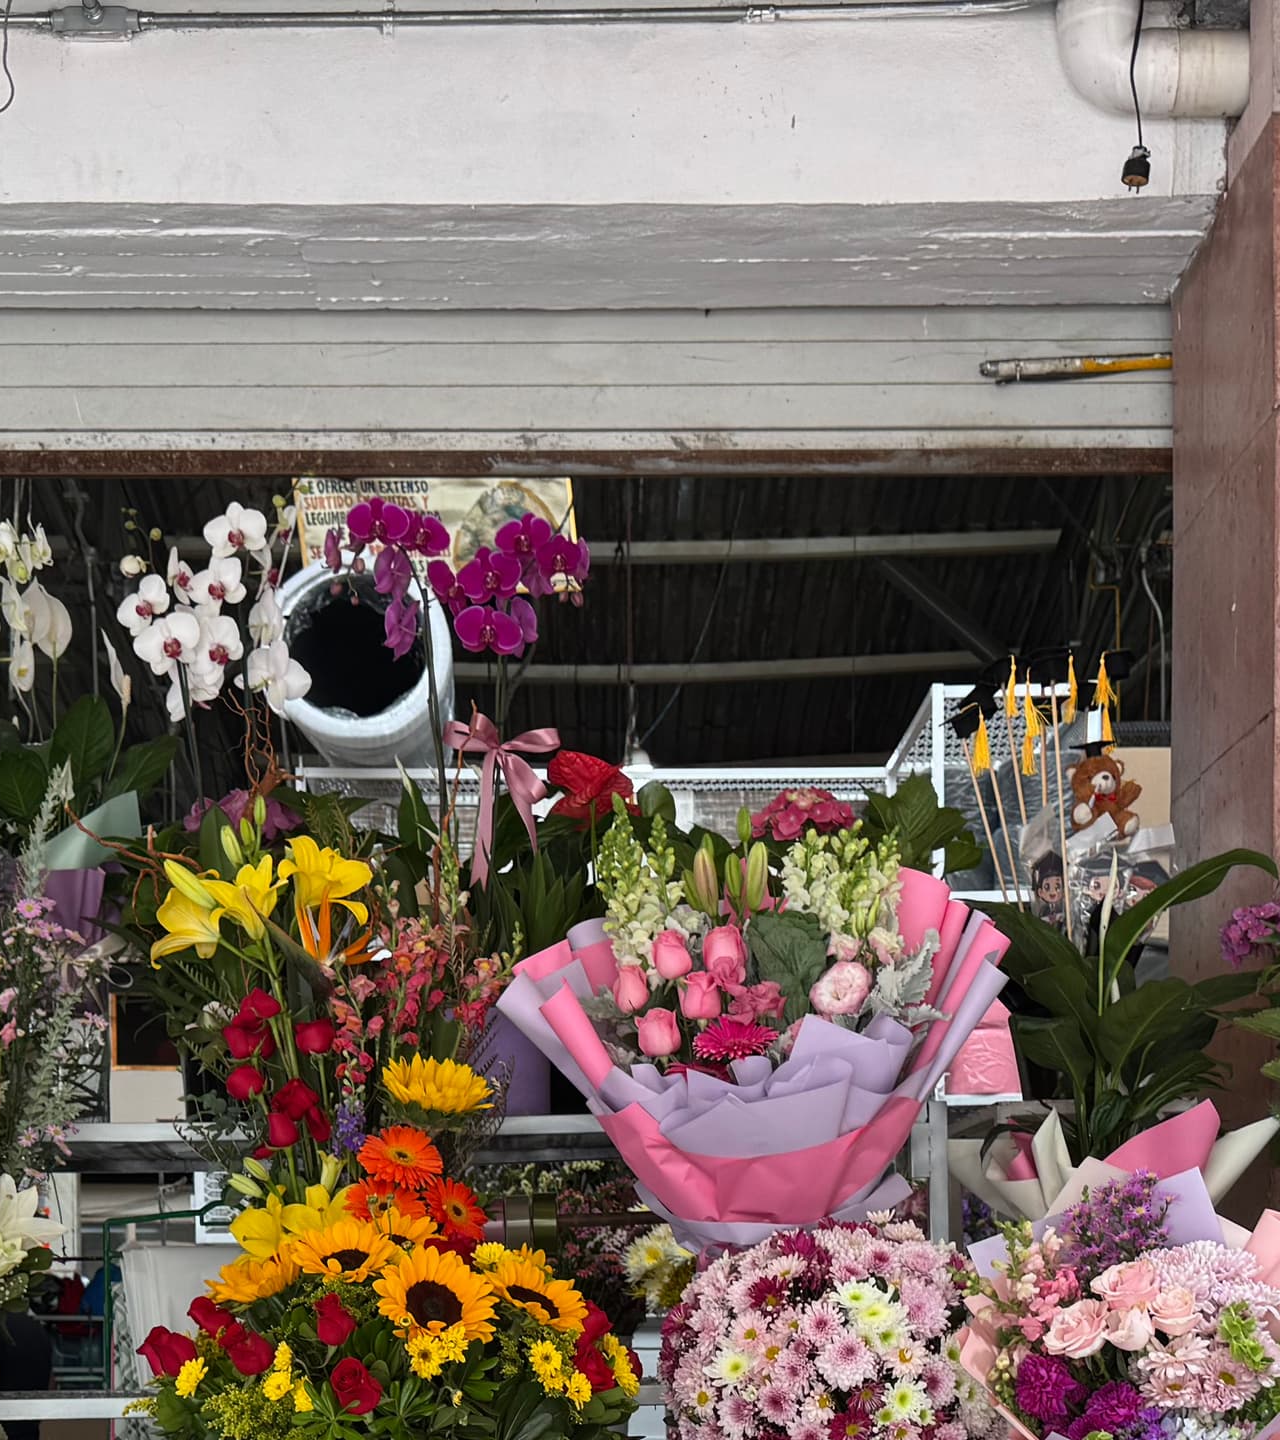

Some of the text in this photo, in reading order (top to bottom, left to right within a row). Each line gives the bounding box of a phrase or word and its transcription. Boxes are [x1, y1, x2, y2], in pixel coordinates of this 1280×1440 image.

[317, 480, 357, 494] OFRECE
[360, 480, 376, 494] UN
[378, 480, 429, 494] EXTENSO
[304, 496, 353, 510] SURTIDO
[421, 496, 429, 509] Y
